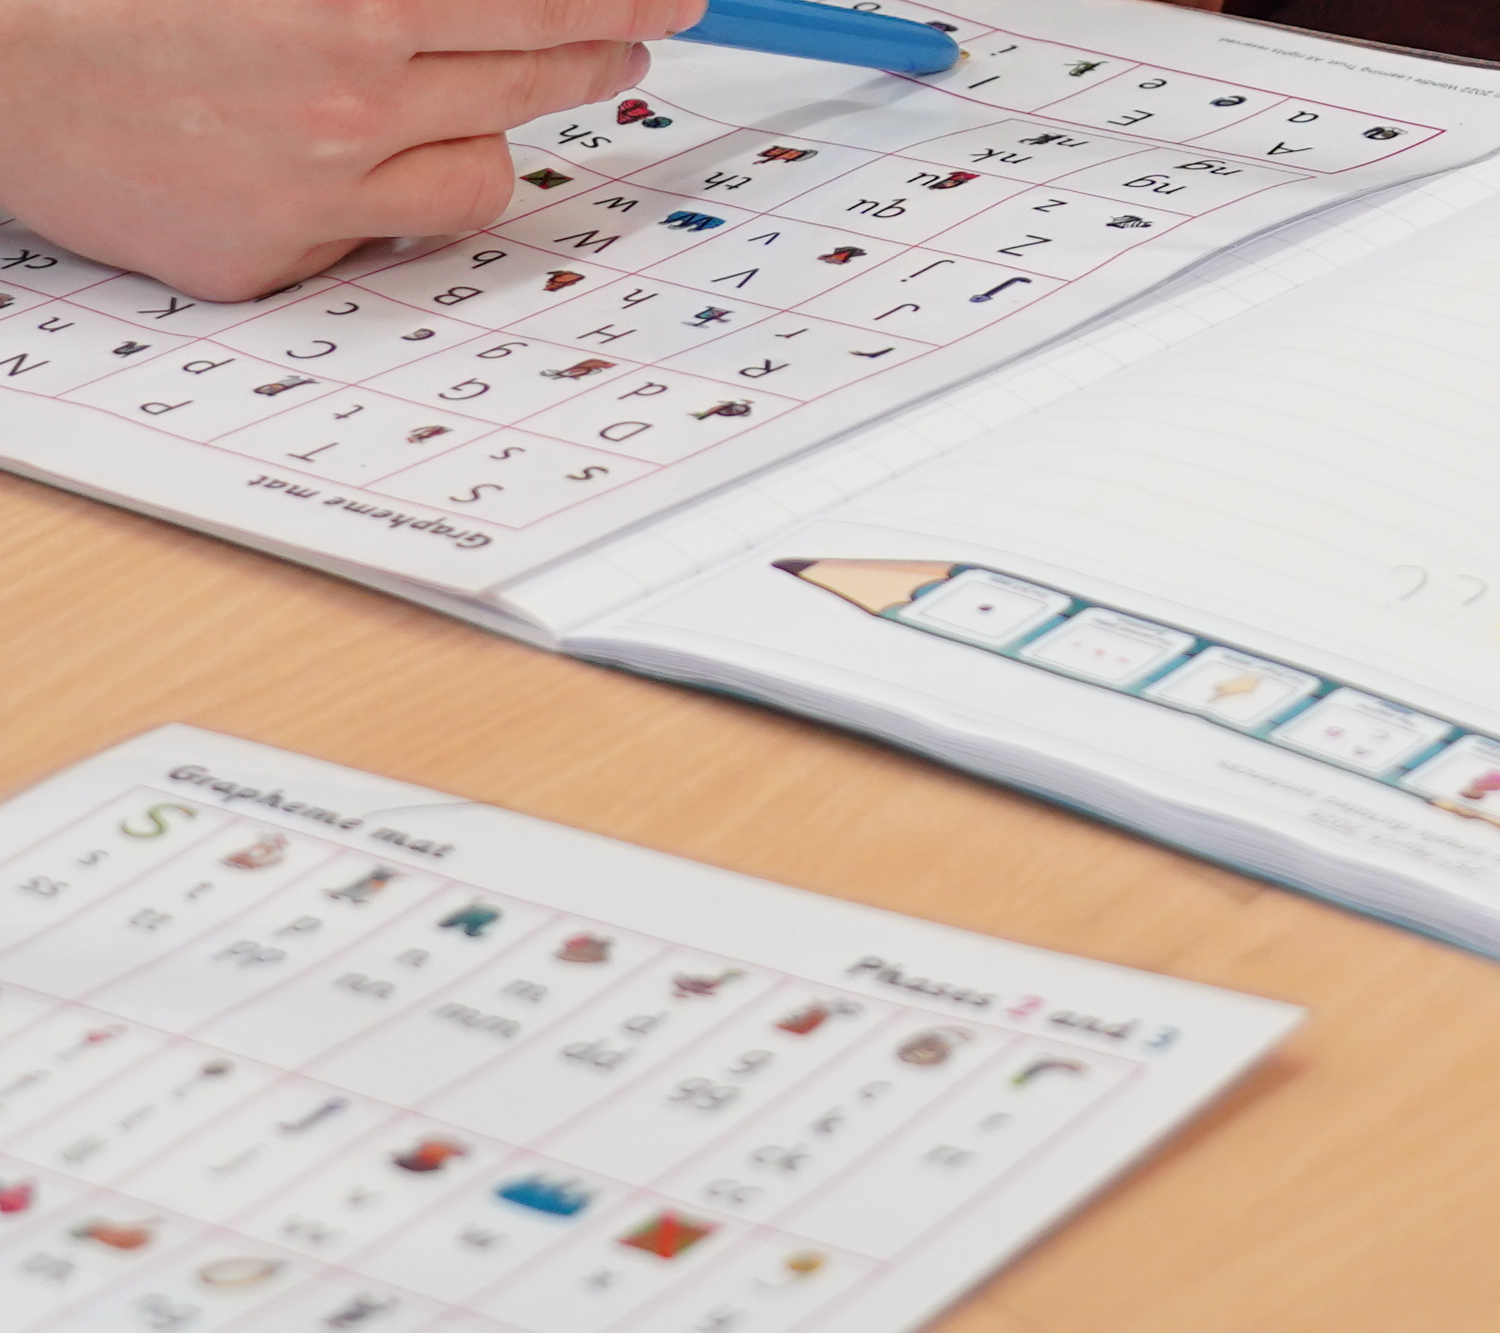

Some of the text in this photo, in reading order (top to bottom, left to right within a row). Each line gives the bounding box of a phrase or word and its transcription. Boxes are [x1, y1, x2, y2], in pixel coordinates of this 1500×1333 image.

[1136, 78, 1170, 91] e
[1105, 110, 1155, 127] E
[556, 123, 613, 150] sh
[968, 146, 1035, 166] nk
[1266, 140, 1315, 158] A
[703, 170, 753, 192] th
[1121, 173, 1188, 196] ng
[591, 195, 642, 215] w
[844, 197, 909, 220] qu
[1030, 197, 1069, 214] z
[551, 228, 622, 255] W
[995, 233, 1054, 259] Z
[0, 248, 59, 272] ck
[469, 248, 508, 271] b
[709, 266, 761, 290] V
[431, 285, 485, 308] B
[620, 287, 660, 311] h
[874, 302, 923, 321] J
[36, 315, 76, 334] n
[575, 323, 639, 346] H
[773, 327, 810, 340] r
[284, 339, 339, 361] C
[475, 339, 529, 360] g
[180, 357, 237, 376] p
[737, 357, 791, 380] R
[436, 377, 492, 402] G
[616, 380, 670, 402] d
[138, 399, 195, 417] P
[332, 403, 366, 421] t
[597, 420, 655, 444] D
[285, 441, 340, 464] T
[488, 446, 527, 462] s
[447, 483, 505, 505] S
[245, 474, 495, 551] Grapheme mat
[167, 762, 458, 863] Grapheme mat
[845, 954, 998, 1011] Phases
[1004, 993, 1046, 1019] 2
[1047, 1007, 1140, 1042] and
